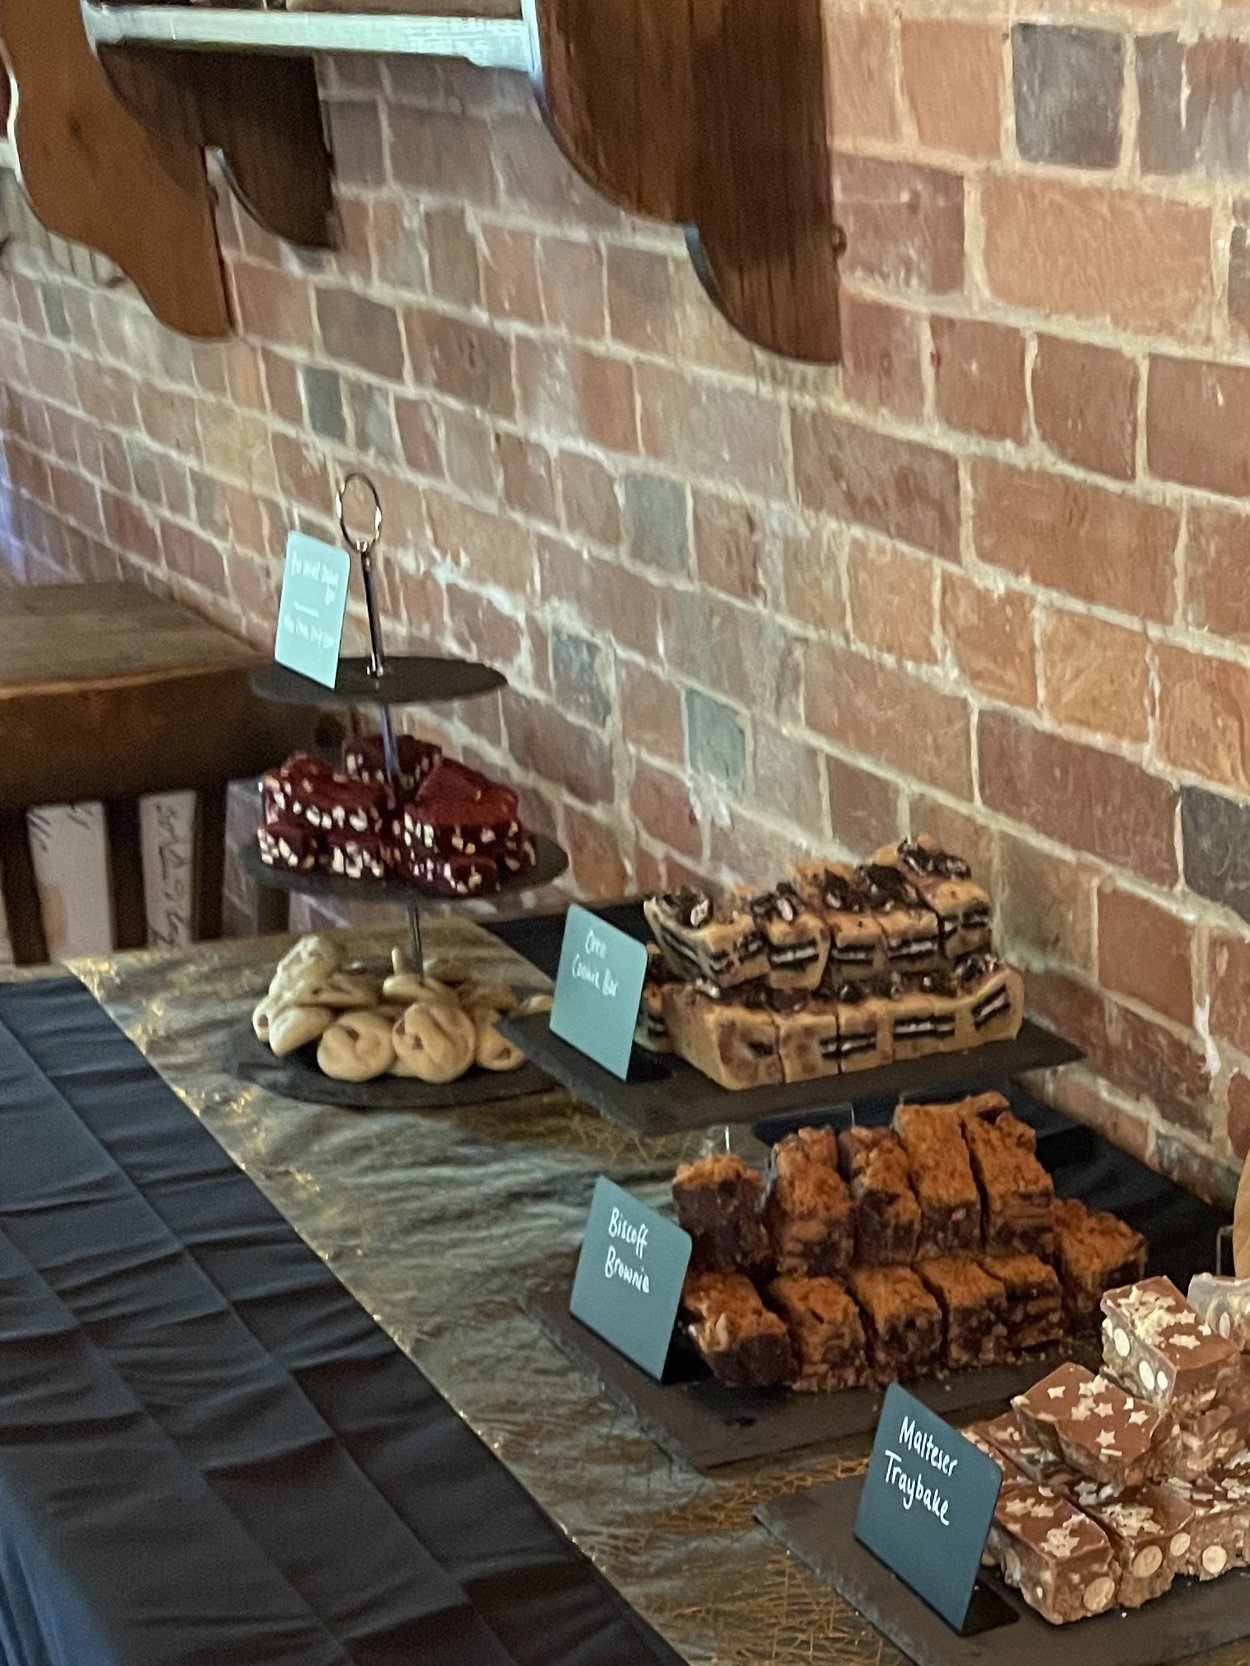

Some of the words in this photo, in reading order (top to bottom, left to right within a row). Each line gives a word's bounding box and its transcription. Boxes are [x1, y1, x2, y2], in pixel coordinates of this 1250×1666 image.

[608, 1206, 649, 1259] Biscoff
[604, 1245, 650, 1293] Brownie
[899, 1415, 958, 1476] Malteser
[884, 1449, 950, 1526] Traybake
